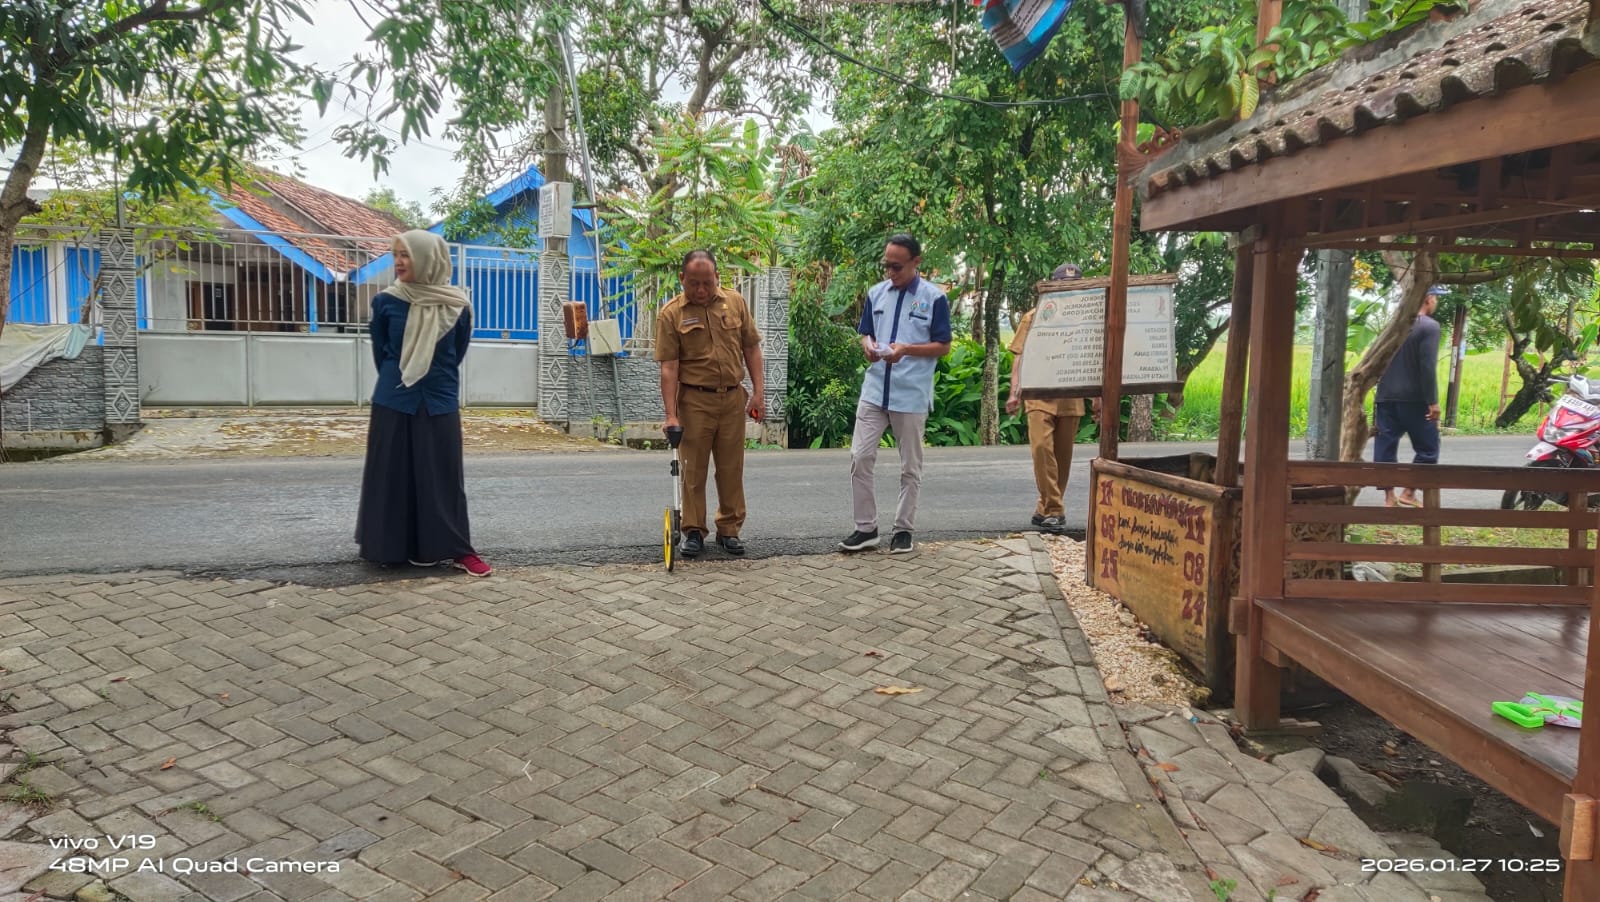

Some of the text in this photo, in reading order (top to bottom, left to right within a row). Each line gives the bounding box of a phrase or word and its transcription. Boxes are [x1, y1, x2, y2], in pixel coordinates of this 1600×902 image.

[1101, 514, 1116, 543] 08
[1184, 551, 1205, 586] 08
[1182, 588, 1205, 626] 24
